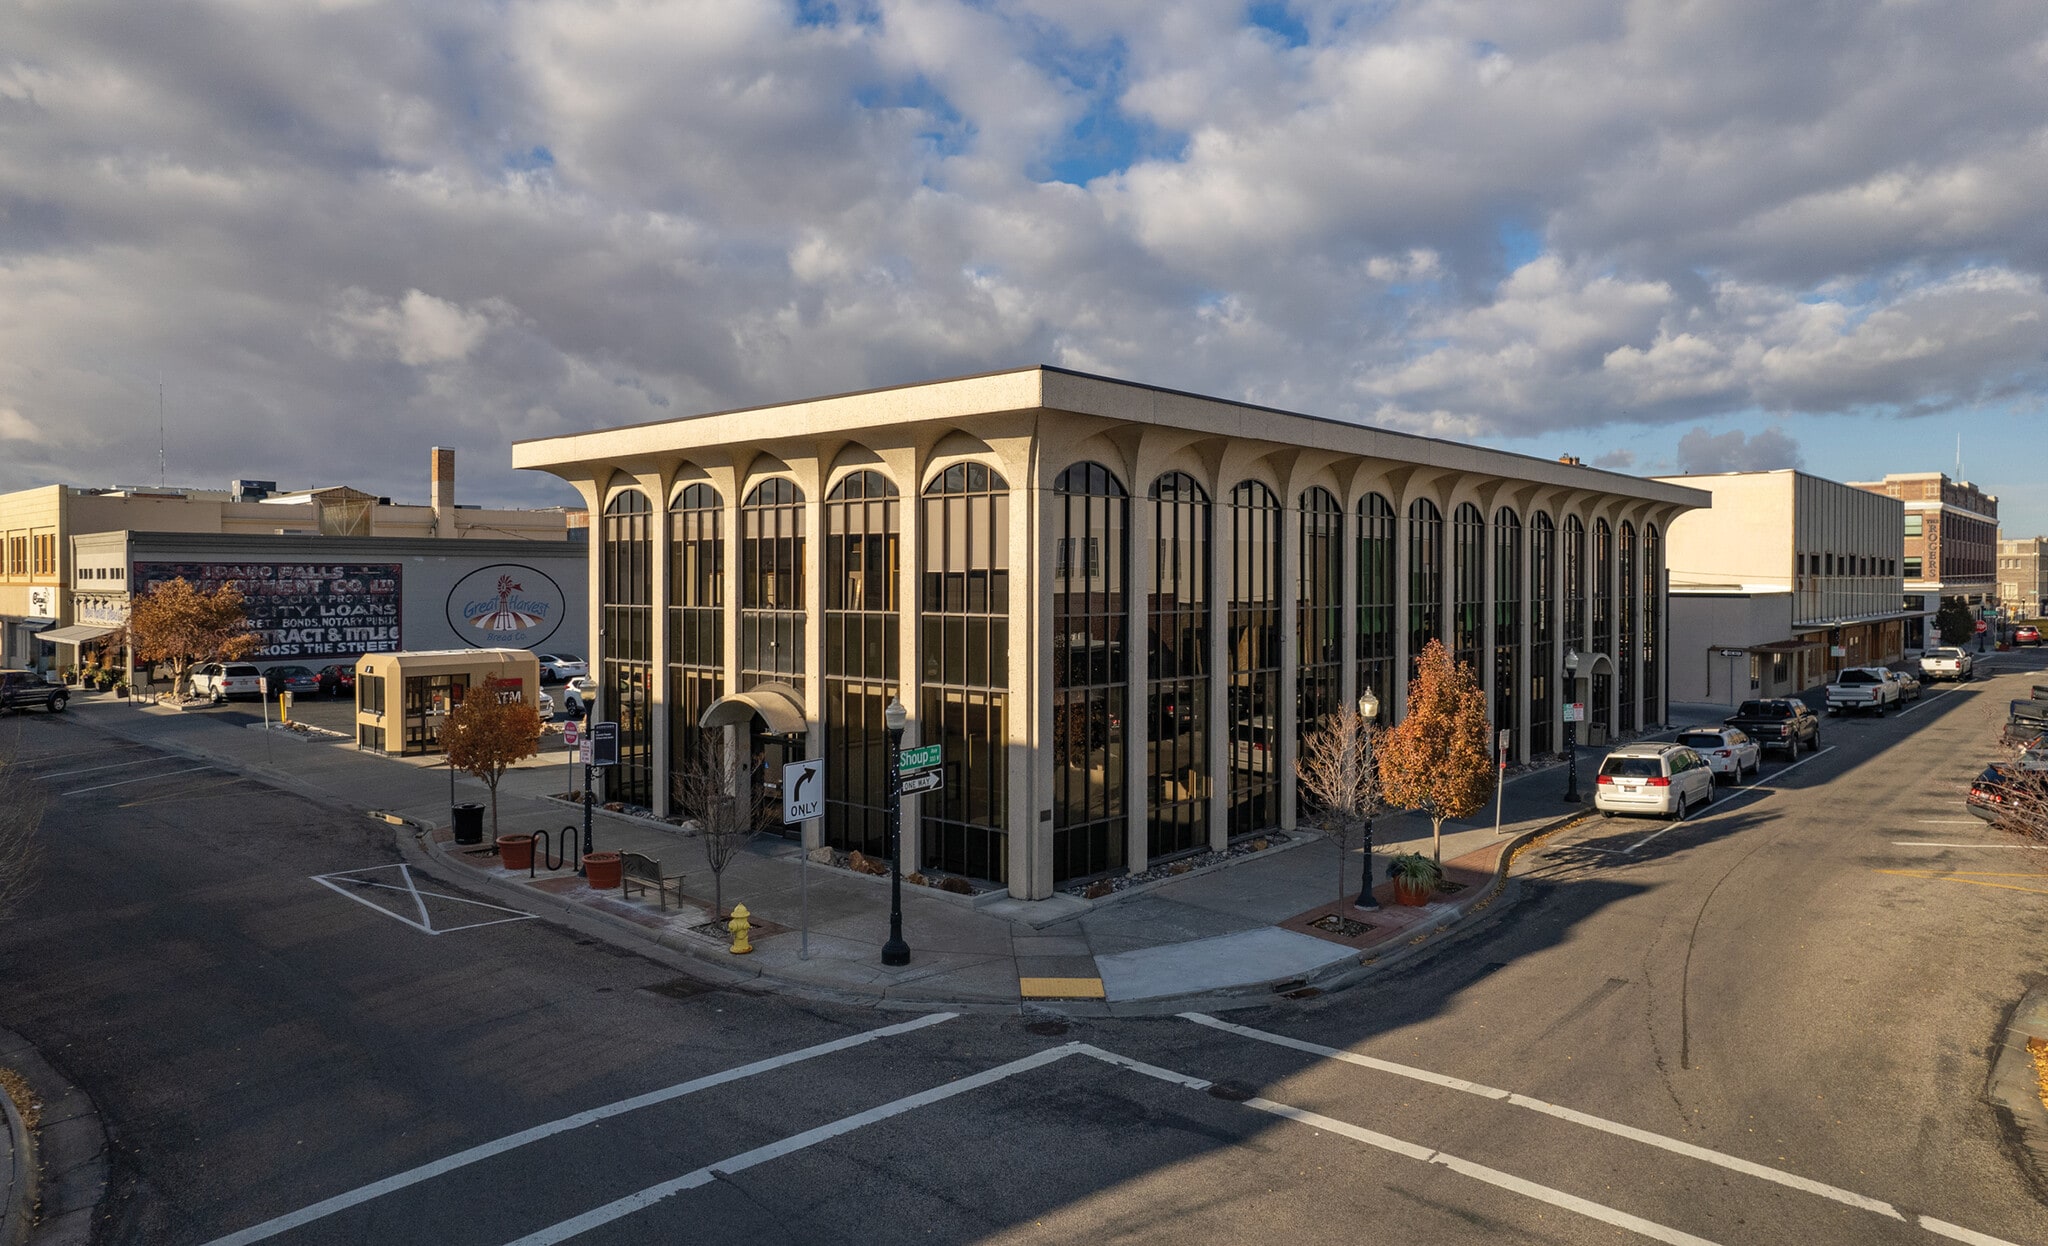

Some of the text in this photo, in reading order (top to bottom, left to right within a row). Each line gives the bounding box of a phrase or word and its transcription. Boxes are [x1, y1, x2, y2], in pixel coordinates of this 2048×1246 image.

[1928, 525, 1938, 577] ROGERS
[204, 566, 344, 579] IDAHO FALLS
[320, 604, 397, 616] LOANS
[464, 595, 550, 618] Great Harvest
[322, 616, 363, 627] NOTARY
[366, 616, 398, 626] PUBLIC
[328, 628, 342, 641] &
[343, 627, 387, 641] TITLE
[487, 632, 513, 641] Bread
[304, 644, 333, 653] THE
[337, 641, 398, 653] STREET
[900, 751, 928, 767] Shoup
[904, 777, 931, 790] ONE WAY
[791, 801, 818, 816] ONLY
